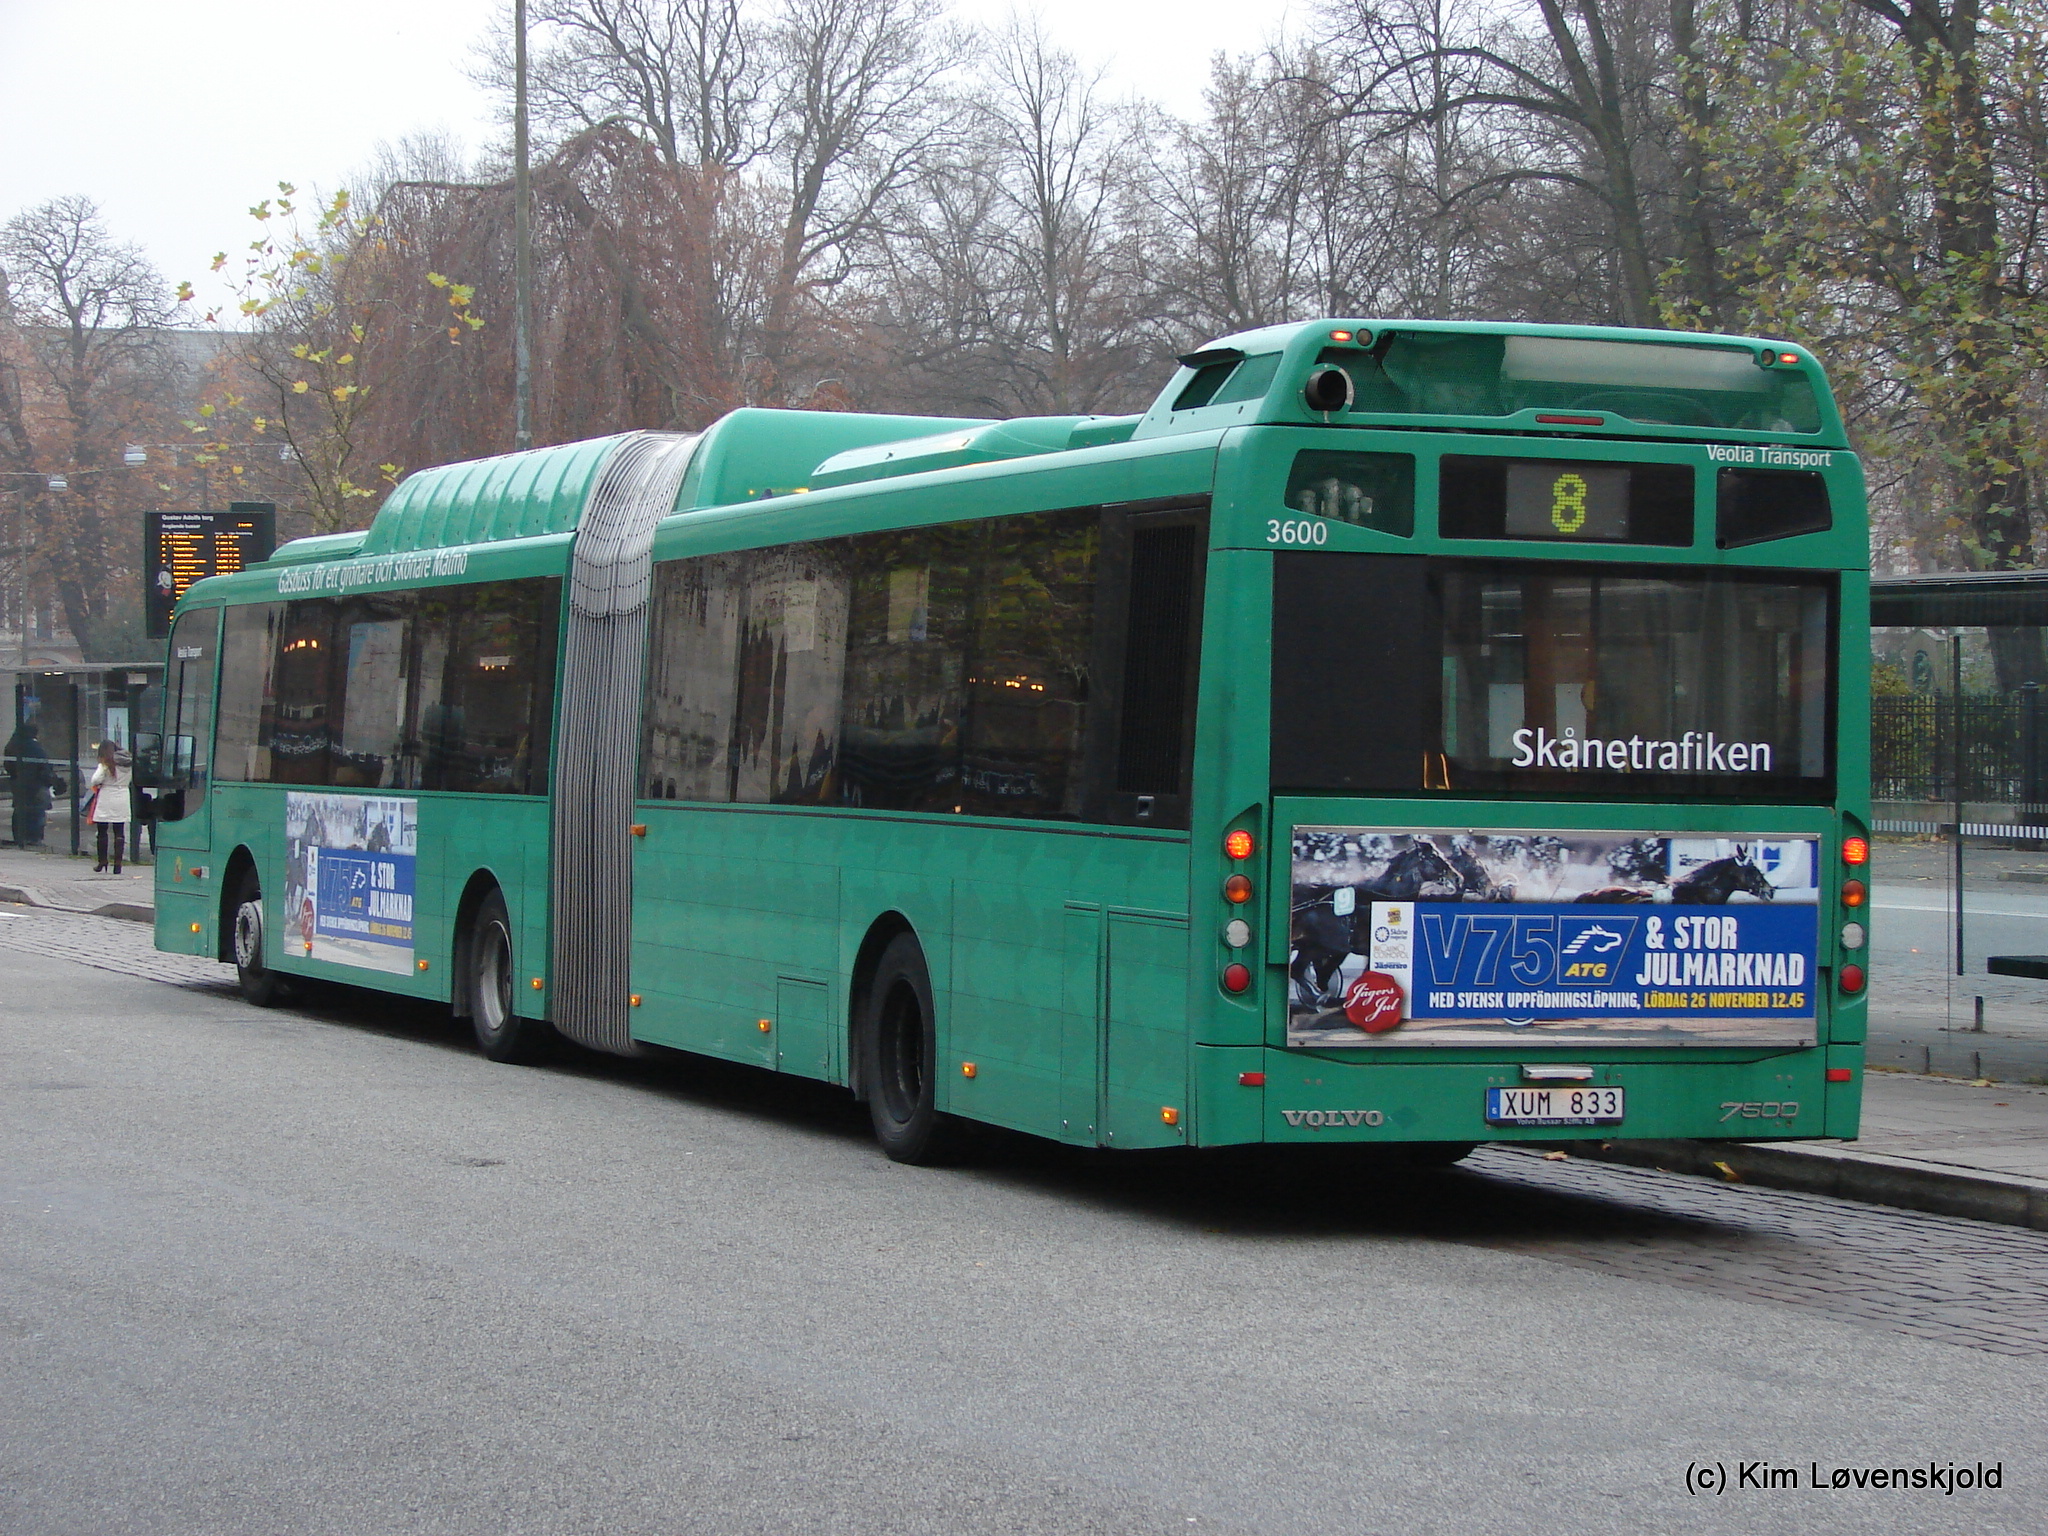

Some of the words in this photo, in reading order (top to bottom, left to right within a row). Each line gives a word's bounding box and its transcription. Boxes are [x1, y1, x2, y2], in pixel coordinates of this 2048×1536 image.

[1706, 444, 1755, 463] Veolia
[1759, 446, 1832, 468] Transport
[1550, 472, 1588, 534] 8
[1266, 519, 1327, 545] 3600
[278, 568, 310, 594] Gasbuss
[312, 564, 325, 590] för
[326, 564, 338, 588] ett
[338, 560, 374, 593] grönare
[374, 556, 392, 583] och
[432, 548, 468, 577] Malmö
[1512, 727, 1772, 772] Skånetrafiken
[377, 862, 396, 890] STOR
[368, 890, 412, 922] JULMARKNAD
[1646, 916, 1666, 950] &
[1674, 916, 1738, 950] STOR
[1420, 914, 1556, 986] V75
[1565, 963, 1608, 978] ATG
[1636, 952, 1805, 986] JULMARKNAD
[1343, 982, 1396, 1009] Jägers
[1430, 992, 1454, 1008] MED
[1458, 992, 1504, 1009] SVENSK
[1507, 990, 1641, 1010] UPPFÖDNINGSLÖPNING,
[1644, 990, 1687, 1008] LÖRDAG
[1690, 992, 1706, 1008] 26
[1709, 992, 1769, 1008] NOVEMBER
[1772, 992, 1805, 1008] 12.45
[1365, 996, 1399, 1023] Jul
[1505, 1091, 1551, 1116] XUM
[1571, 1091, 1616, 1115] 833
[1718, 1102, 1800, 1123] 7500
[1282, 1109, 1384, 1128] VOLVO
